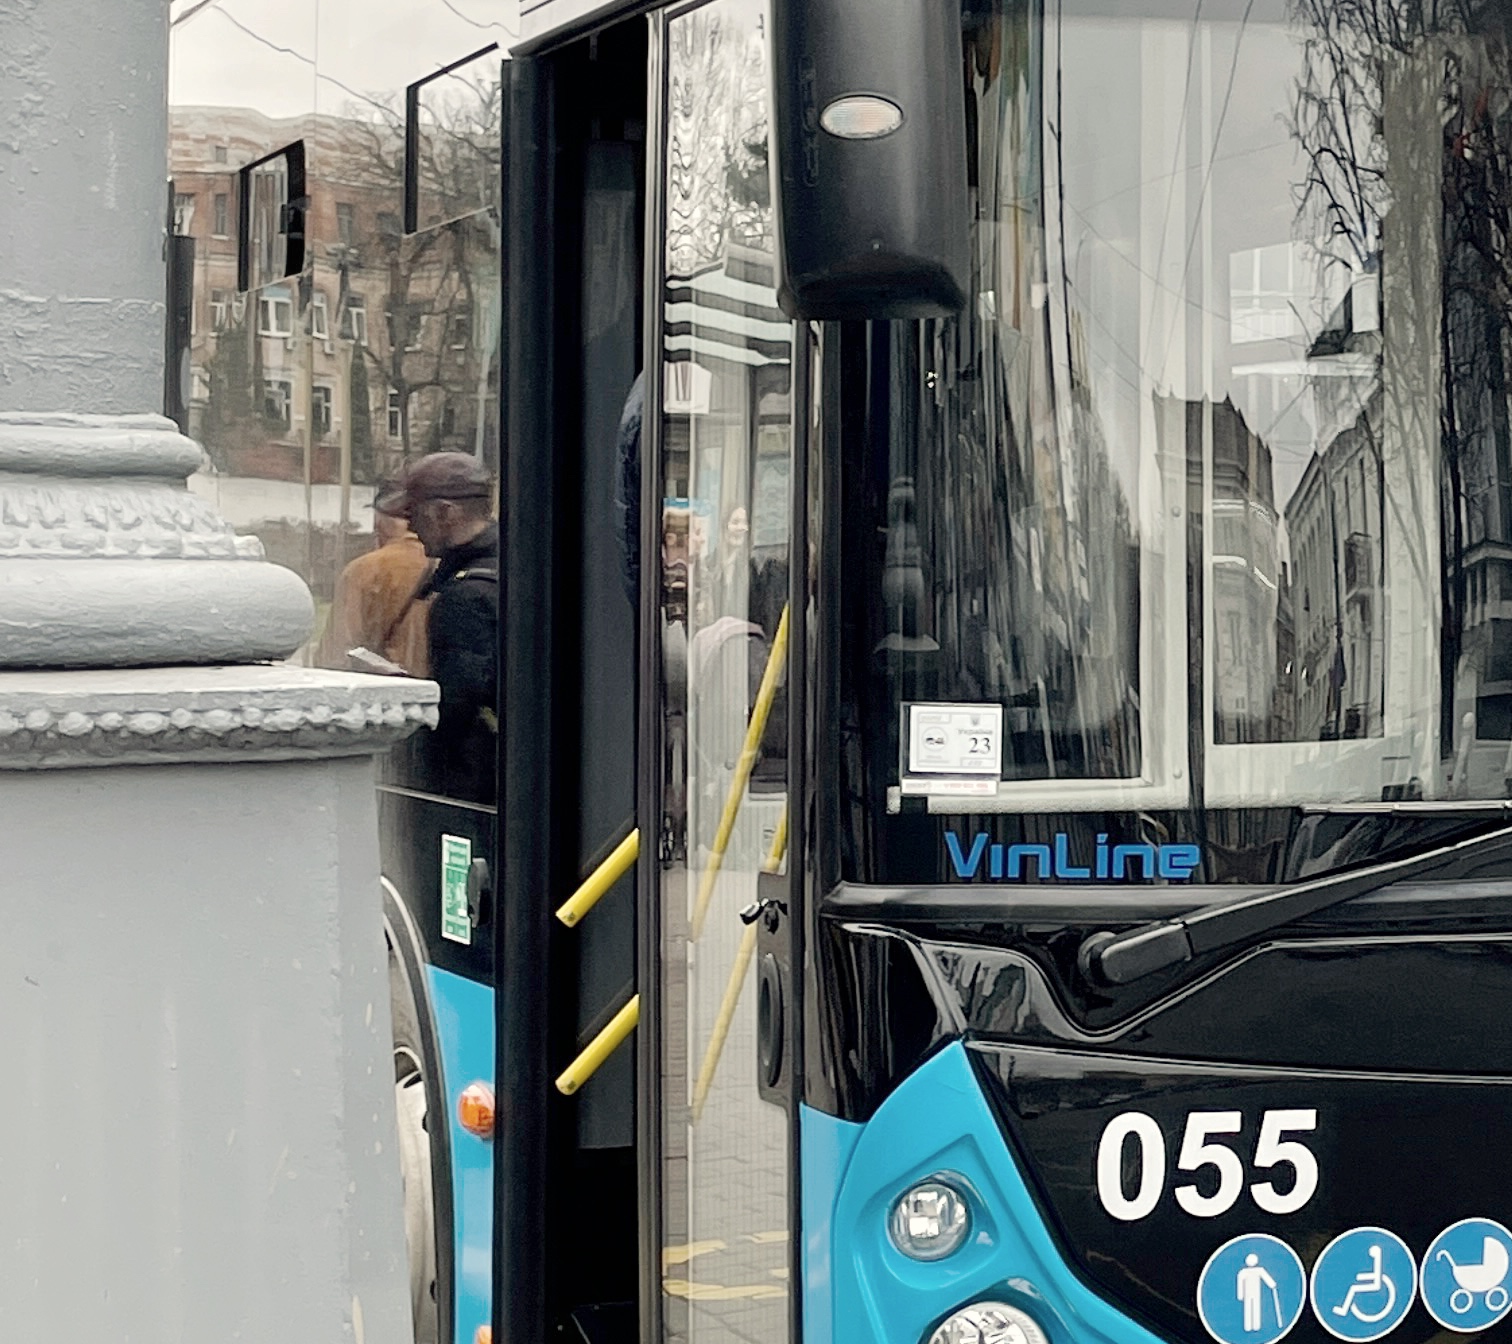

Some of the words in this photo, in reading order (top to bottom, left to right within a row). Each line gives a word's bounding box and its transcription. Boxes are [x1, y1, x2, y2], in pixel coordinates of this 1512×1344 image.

[968, 737, 991, 755] 23
[944, 831, 1200, 878] VinLine
[1096, 1108, 1320, 1221] 055
